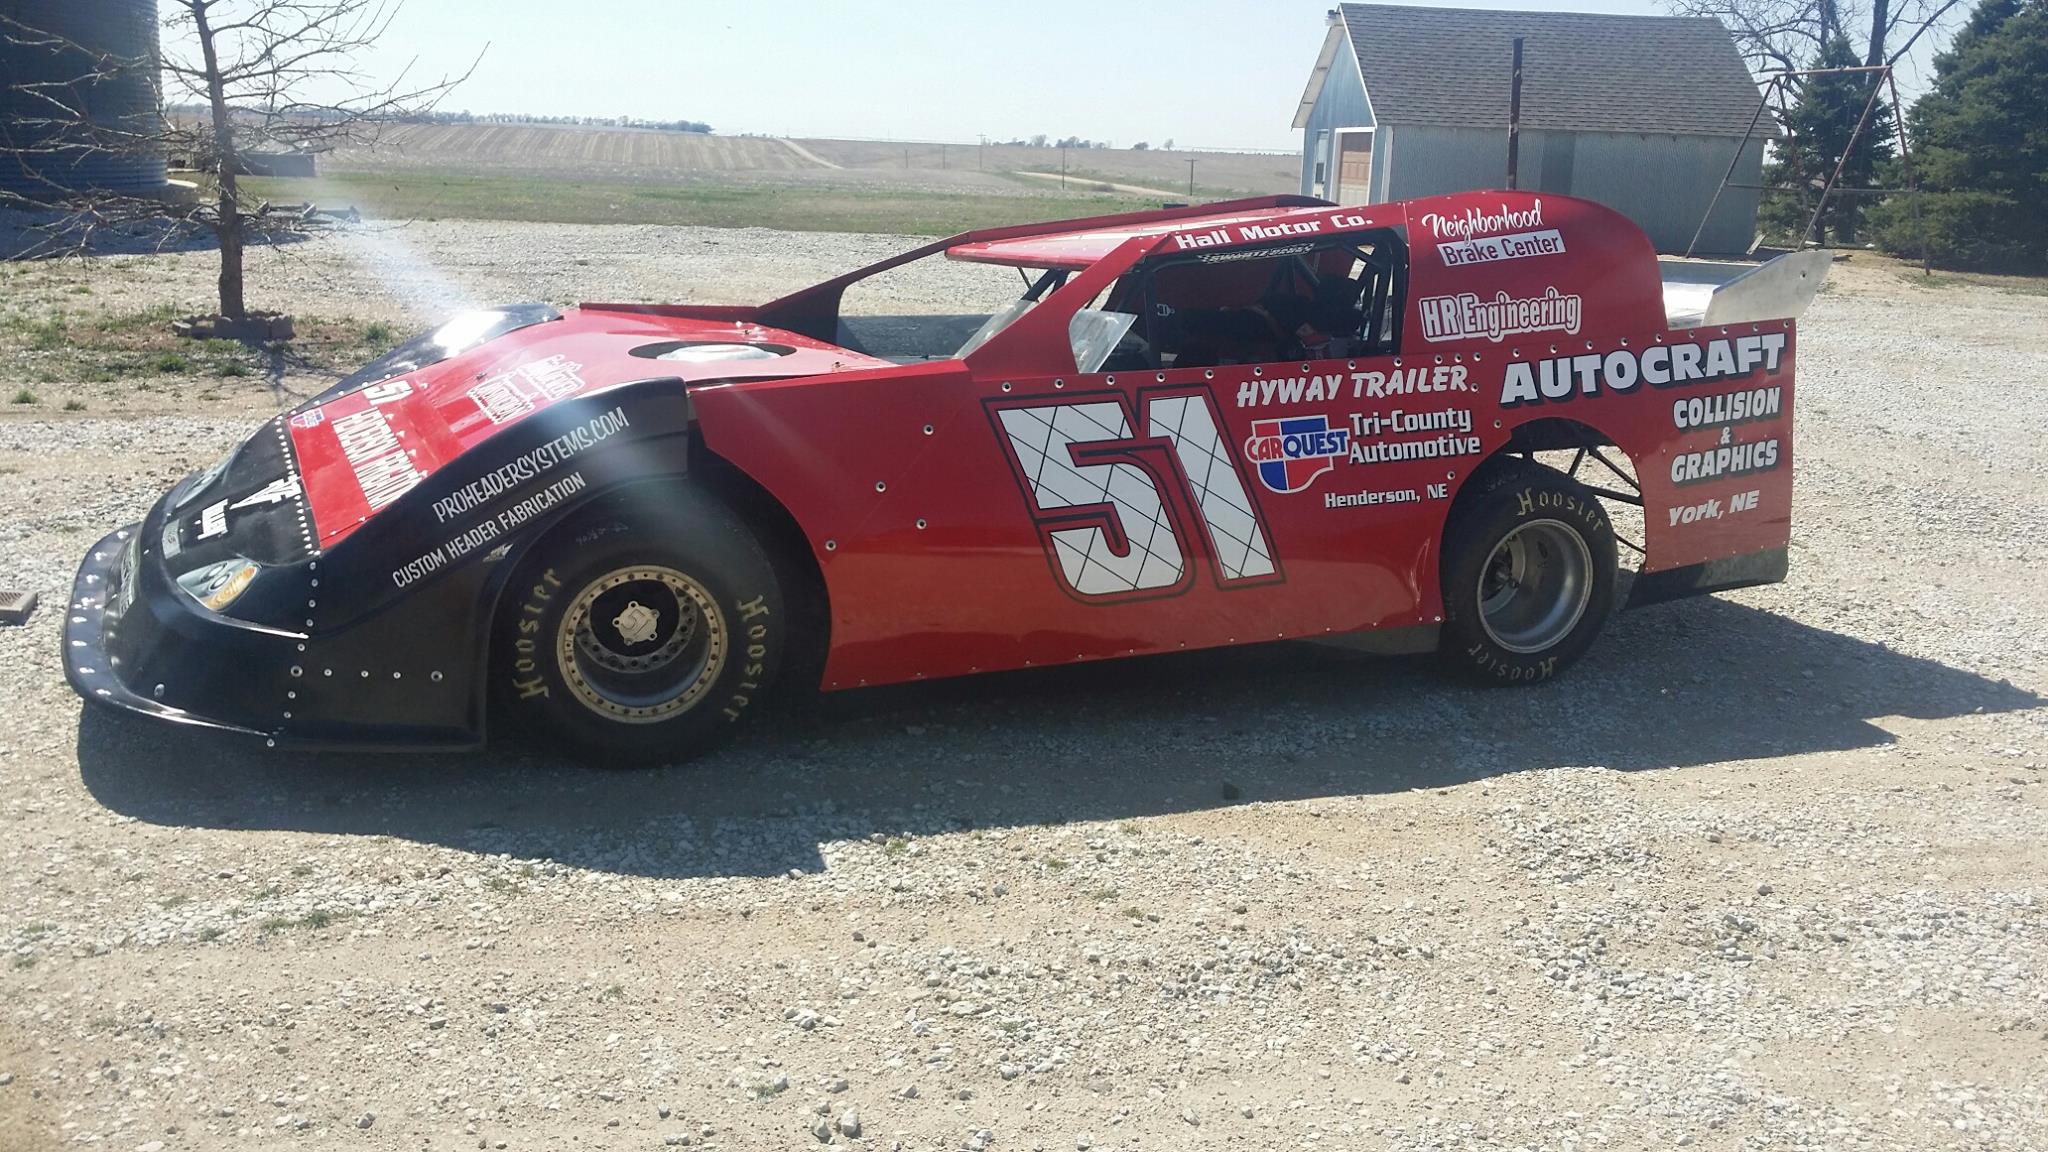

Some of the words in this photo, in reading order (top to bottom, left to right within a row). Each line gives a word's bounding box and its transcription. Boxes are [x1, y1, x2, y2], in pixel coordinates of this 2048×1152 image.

[1175, 229, 1231, 249] Hall
[1239, 220, 1322, 241] Motor
[1330, 214, 1373, 229] Co.
[1421, 198, 1544, 246] Neighborhood
[1442, 241, 1499, 265] Brake
[1501, 234, 1559, 257] Center
[1237, 374, 1343, 407] HYWAY
[1351, 365, 1468, 399] TRAILER
[1500, 333, 1785, 404] AUTOCRAFT
[1349, 408, 1472, 437] Tri-County
[1673, 386, 1780, 429] COLLISION
[1246, 430, 1349, 462] CARQUEST
[1349, 434, 1481, 464] Automotive
[1720, 426, 1732, 445] &
[432, 406, 630, 523] PROHEADERSYSTEMS.COM
[1671, 439, 1778, 482] GRAPHICS
[988, 389, 1283, 602] 51
[1324, 487, 1421, 508] Henderson,
[1426, 483, 1448, 500] NE
[1516, 487, 1604, 531] Hoosier
[1668, 498, 1724, 527] York,
[1729, 489, 1760, 514] NE
[392, 548, 447, 589] CUSTOM
[445, 519, 498, 559] HEADER
[497, 471, 586, 531] FABRICATION
[512, 567, 561, 700] Hoosier
[722, 594, 769, 722] Hoosier
